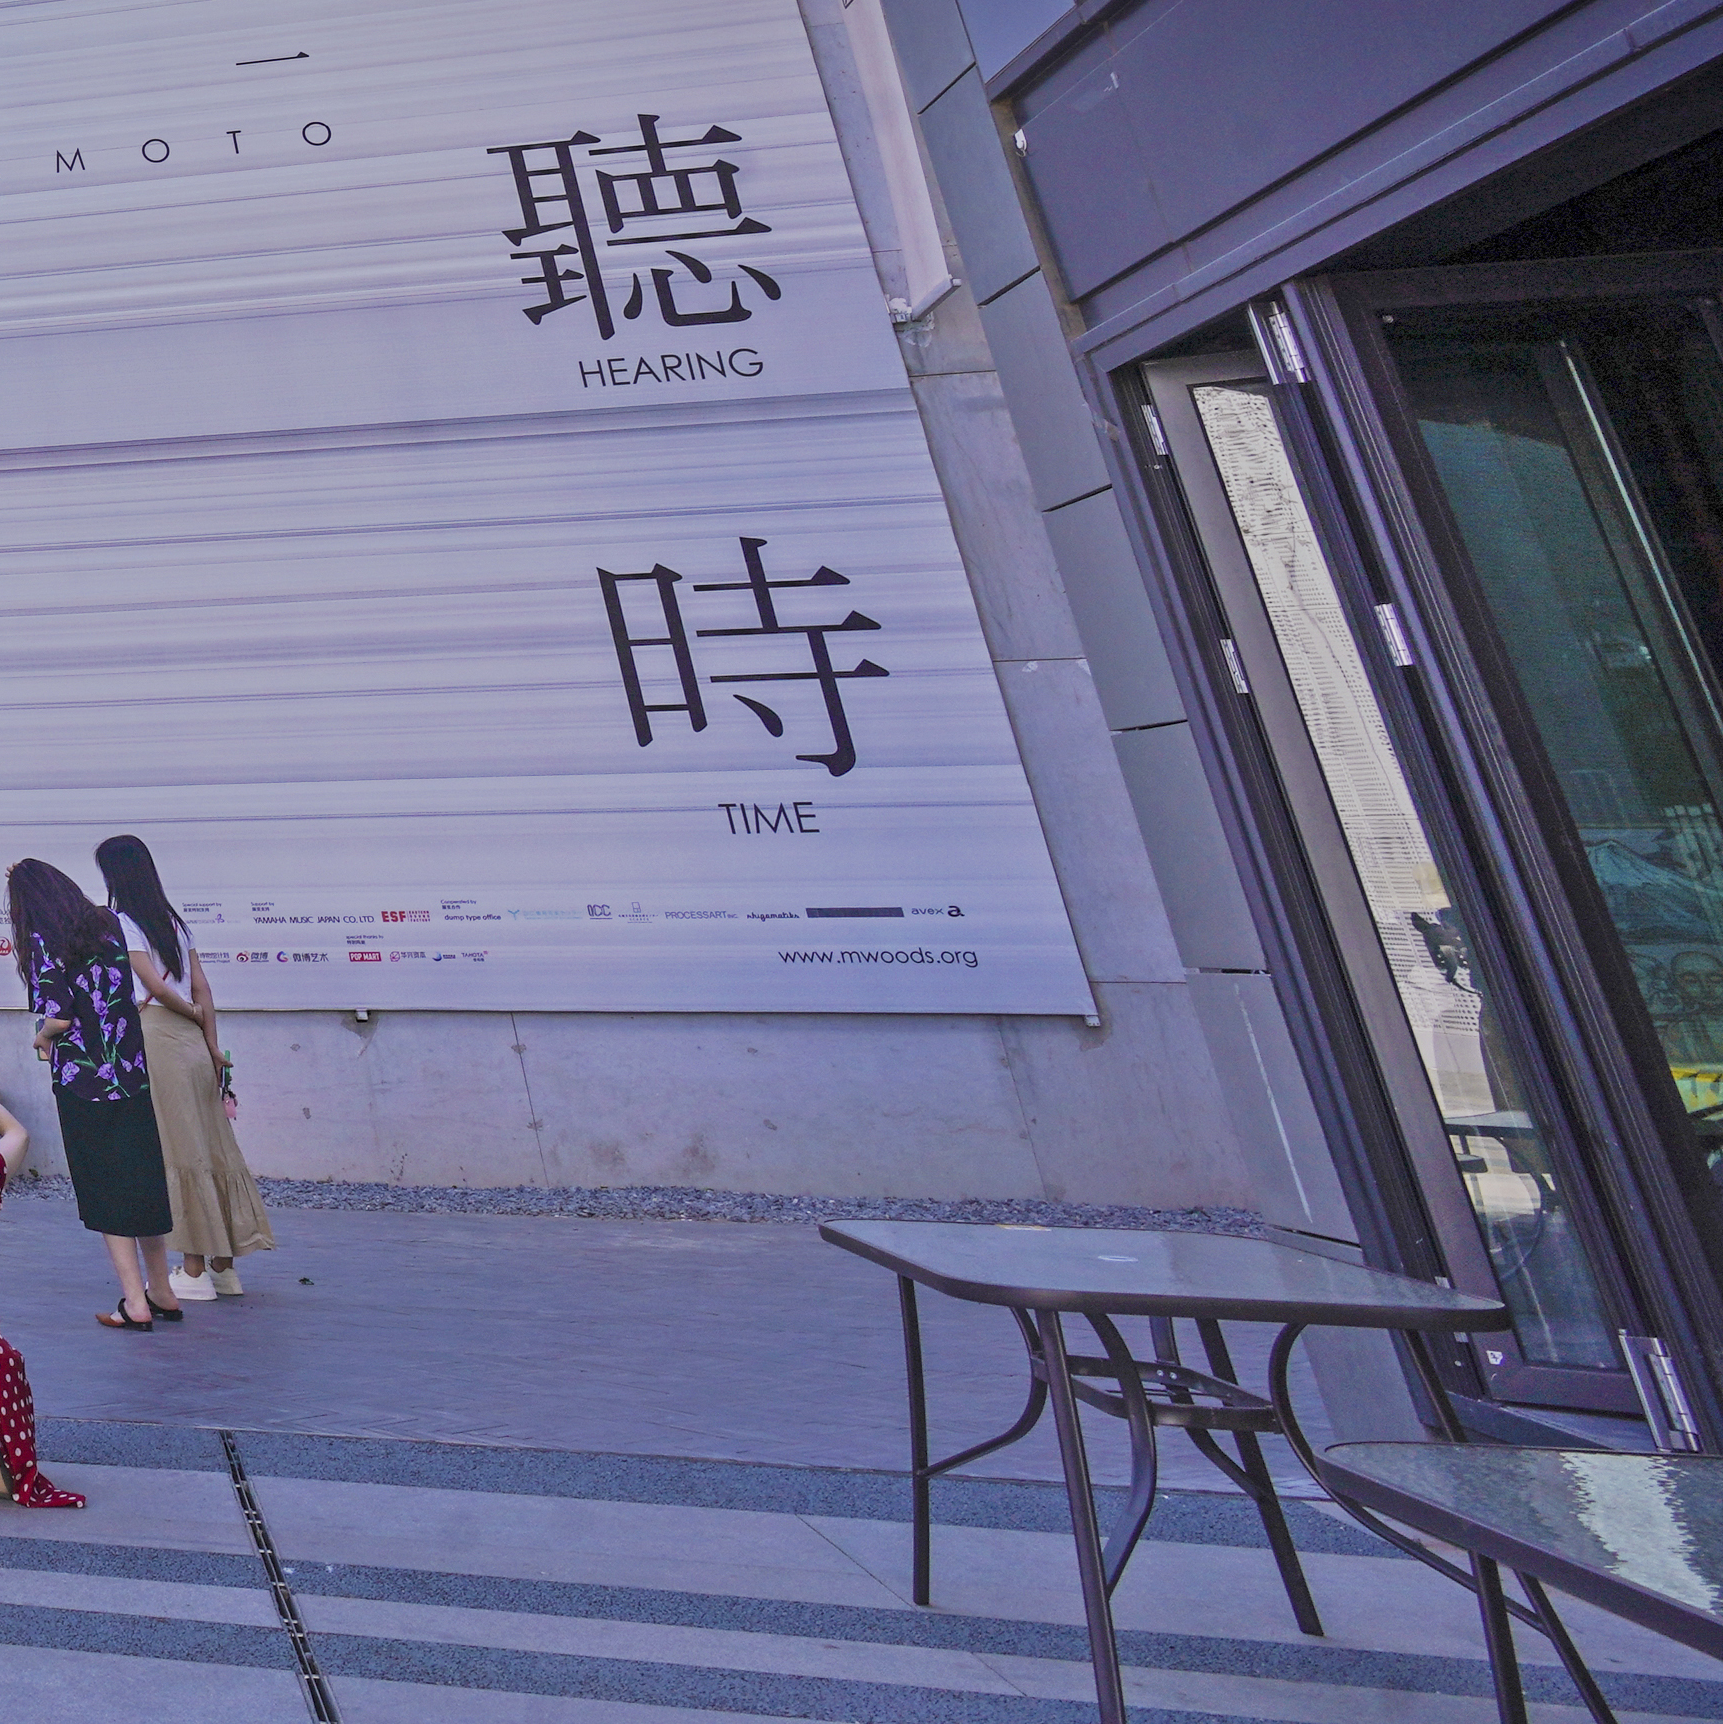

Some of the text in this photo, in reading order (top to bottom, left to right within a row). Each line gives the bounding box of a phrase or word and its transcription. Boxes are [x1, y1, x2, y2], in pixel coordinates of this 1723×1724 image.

[486, 114, 781, 340] 聽
[578, 347, 764, 388] HEARING
[596, 536, 890, 778] 時
[718, 801, 820, 835] TIME
[381, 910, 406, 922] ESF
[665, 910, 727, 919] PROCESSART
[911, 906, 944, 915] avex
[253, 916, 287, 924] YAMAHA
[289, 916, 314, 924] MUSIC
[317, 916, 340, 924] JAPAN
[364, 952, 381, 961] MART
[778, 947, 979, 968] www.mwoods.org
